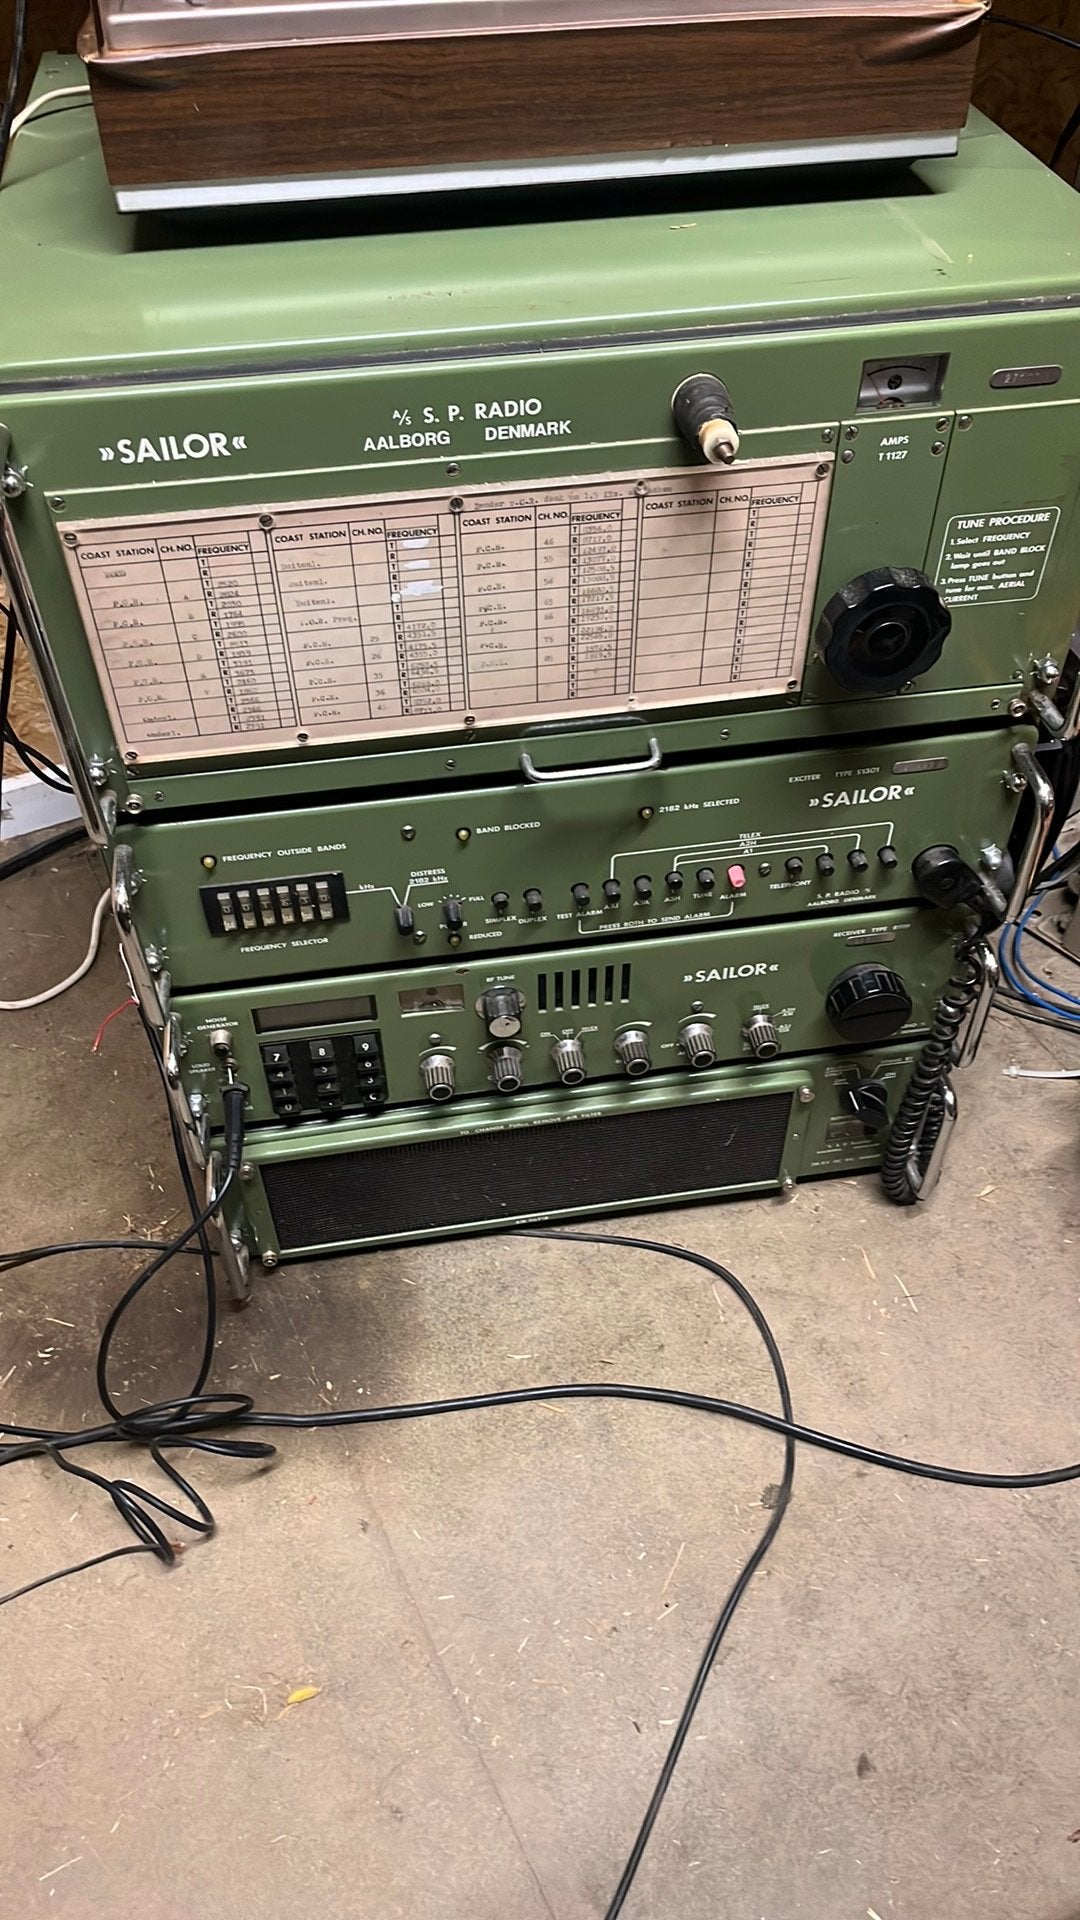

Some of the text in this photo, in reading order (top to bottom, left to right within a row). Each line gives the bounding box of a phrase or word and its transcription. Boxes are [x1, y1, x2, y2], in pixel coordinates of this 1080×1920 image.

[423, 407, 440, 424] S.
[448, 405, 464, 422] P.
[475, 398, 542, 419] RADIO
[364, 420, 572, 451] AALBORG DENMARK
[880, 436, 909, 446] AMPS
[879, 451, 908, 460] T 1127
[646, 497, 714, 510] COAST STATION
[752, 496, 799, 506] FREQUENCY
[462, 515, 532, 527] COAST STATION
[571, 512, 621, 522] FREQUENCY
[957, 512, 1051, 529] TUNE PROCEDURE
[275, 530, 346, 543] COAST STATION
[387, 528, 438, 538] FREQUENCY
[983, 532, 1031, 542] FREQUENCY
[81, 547, 155, 560] COAST STATION
[197, 544, 249, 554] FREQUENCY
[994, 548, 1017, 556] BAND
[1020, 544, 1046, 553] BLOCK
[969, 574, 989, 582] TUNE
[998, 580, 1025, 589] AERIAL
[944, 594, 978, 603] CURRENT
[788, 774, 821, 783] EXCITER
[659, 804, 680, 813] 2182
[703, 798, 740, 808] SELECTED
[476, 821, 541, 834] BAND BLOCKED
[222, 843, 347, 862] FREQUENCY OUTSIDE BANDS
[410, 868, 445, 877] DISTRESS
[720, 892, 747, 900] ALARM
[600, 922, 621, 930] PRESS
[684, 912, 711, 920] ALARM
[469, 931, 503, 940] REDUCED
[240, 938, 329, 953] FREQUENCY SELECTOR
[318, 1047, 326, 1056] 8
[362, 1042, 370, 1051] 9
[273, 1053, 280, 1061] 7
